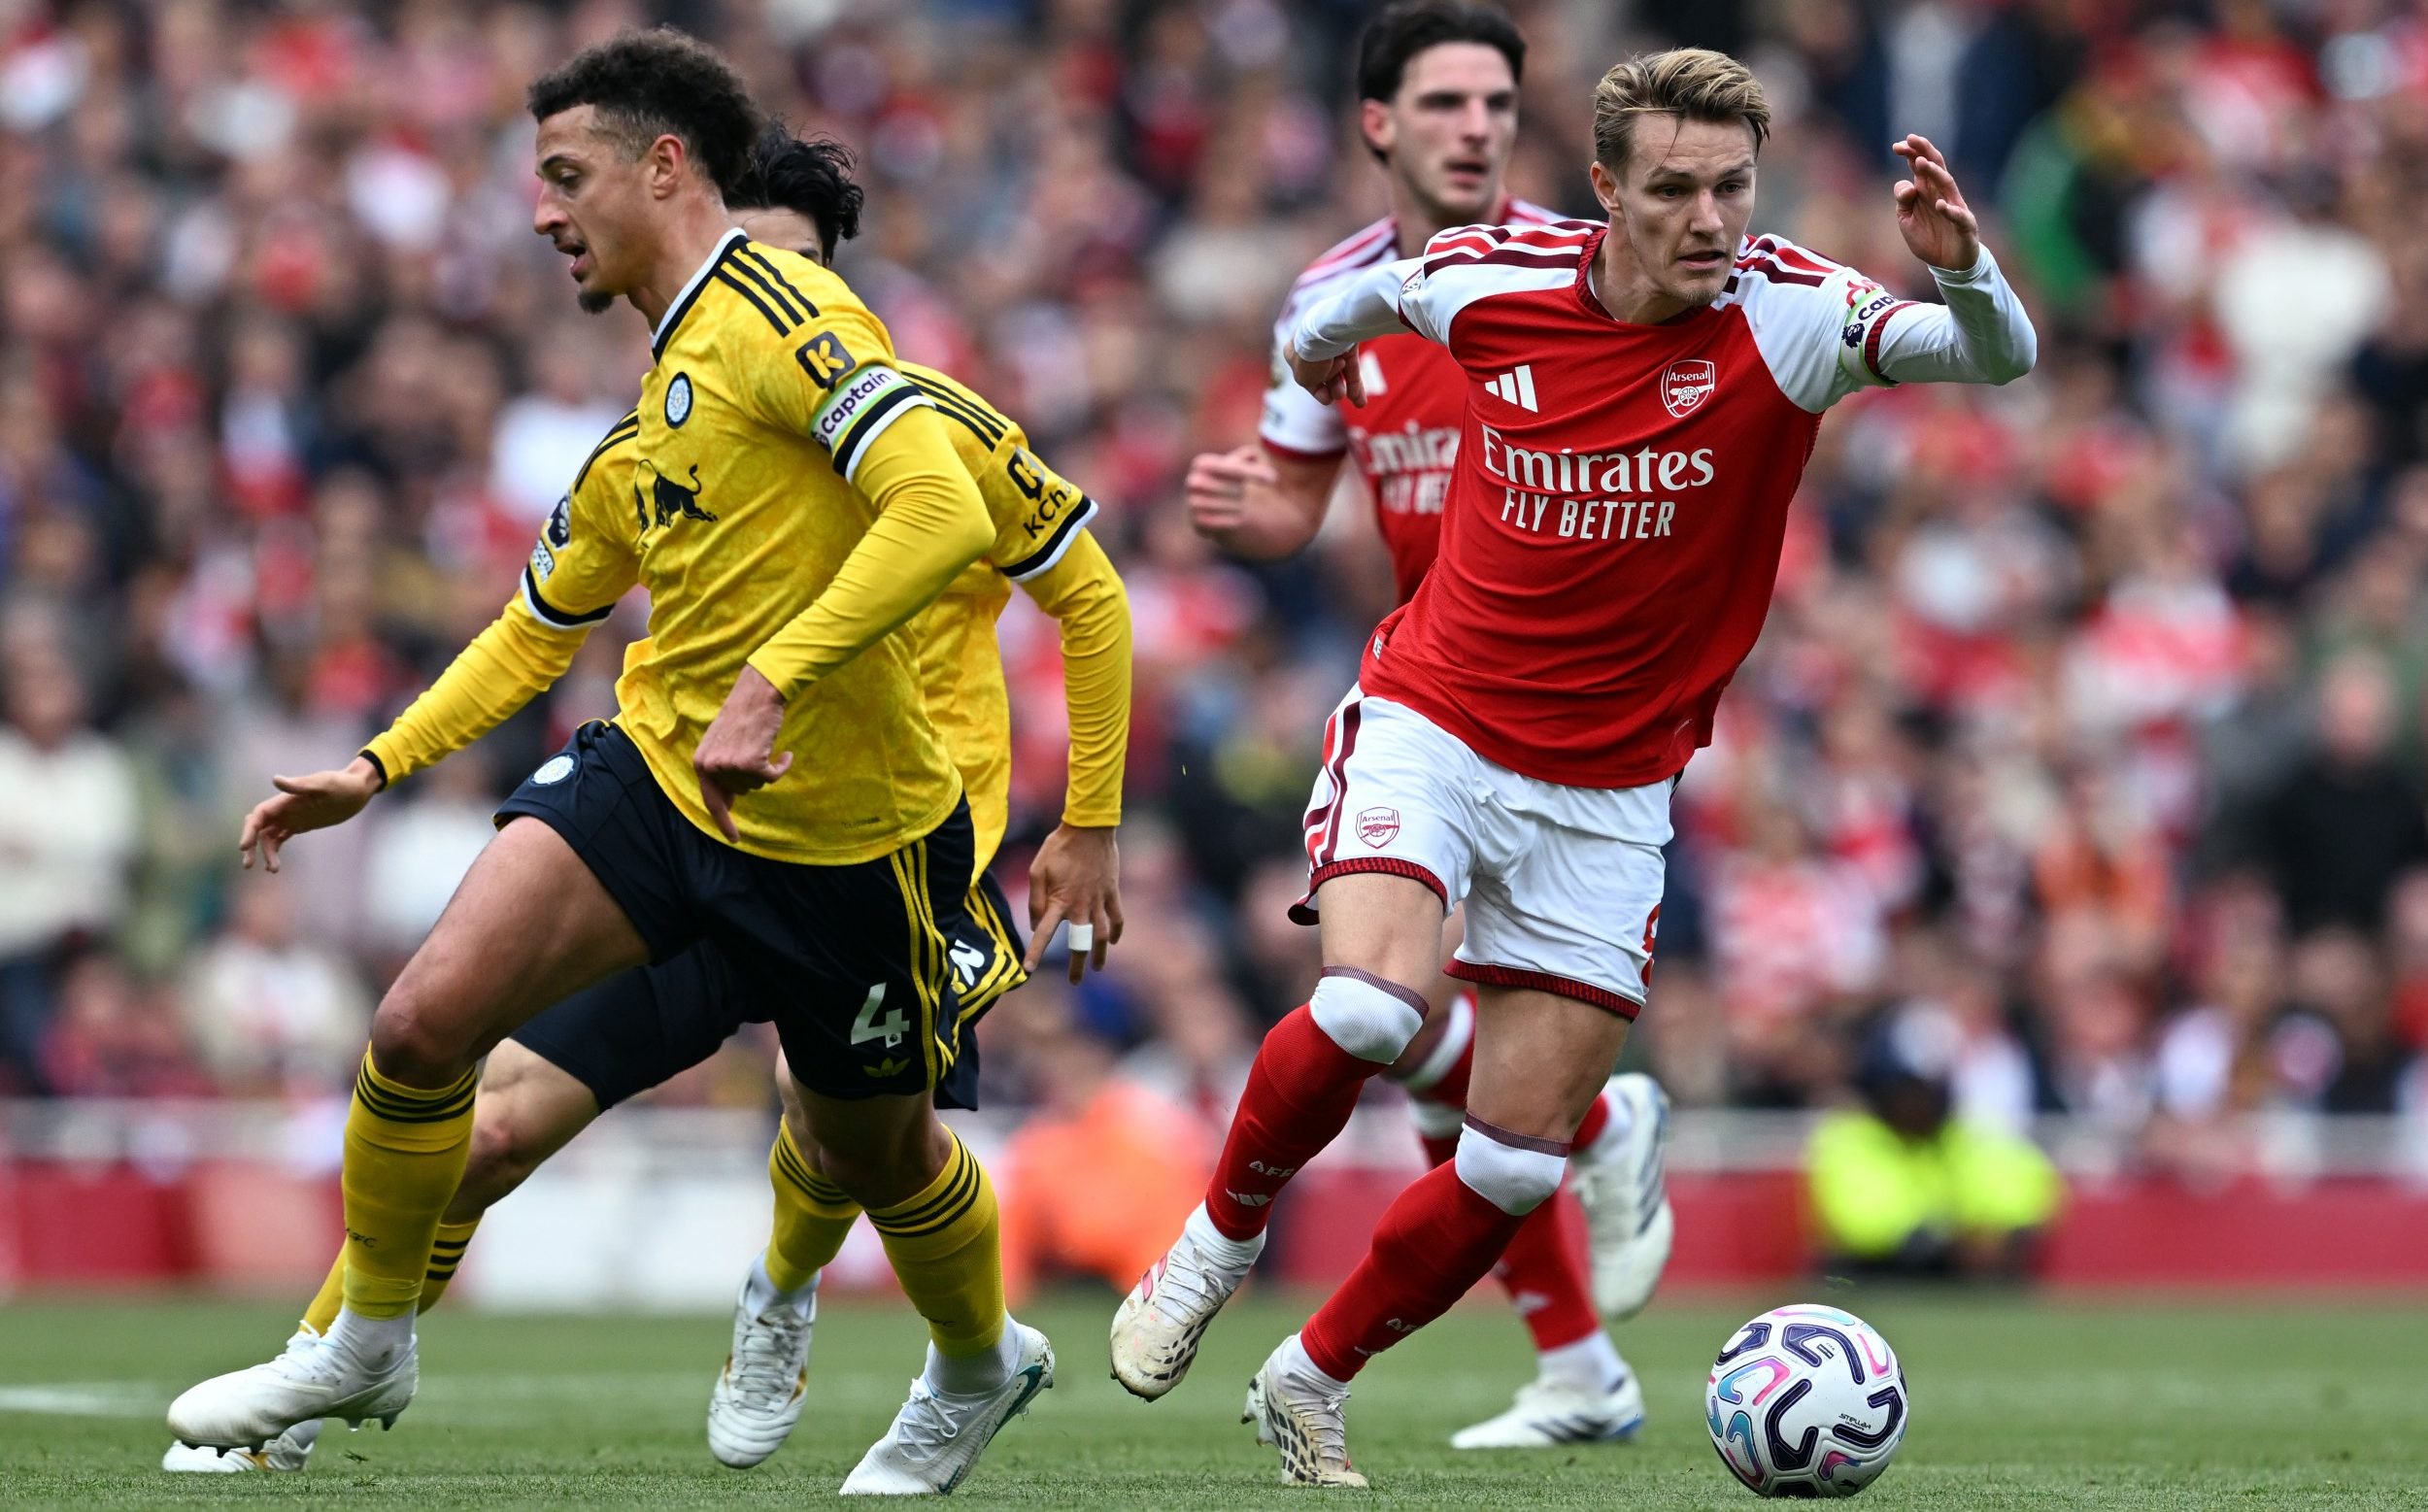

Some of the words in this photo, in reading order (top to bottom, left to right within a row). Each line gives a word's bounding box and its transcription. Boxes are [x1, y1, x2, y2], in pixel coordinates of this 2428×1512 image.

[821, 372, 892, 434] Captain
[1669, 369, 1708, 382] Arsenal
[1482, 423, 1714, 492] Emirates
[1501, 487, 1550, 532] FLY
[1558, 499, 1675, 540] BETTER
[1362, 814, 1394, 823] Arsenal
[851, 982, 910, 1049] 4
